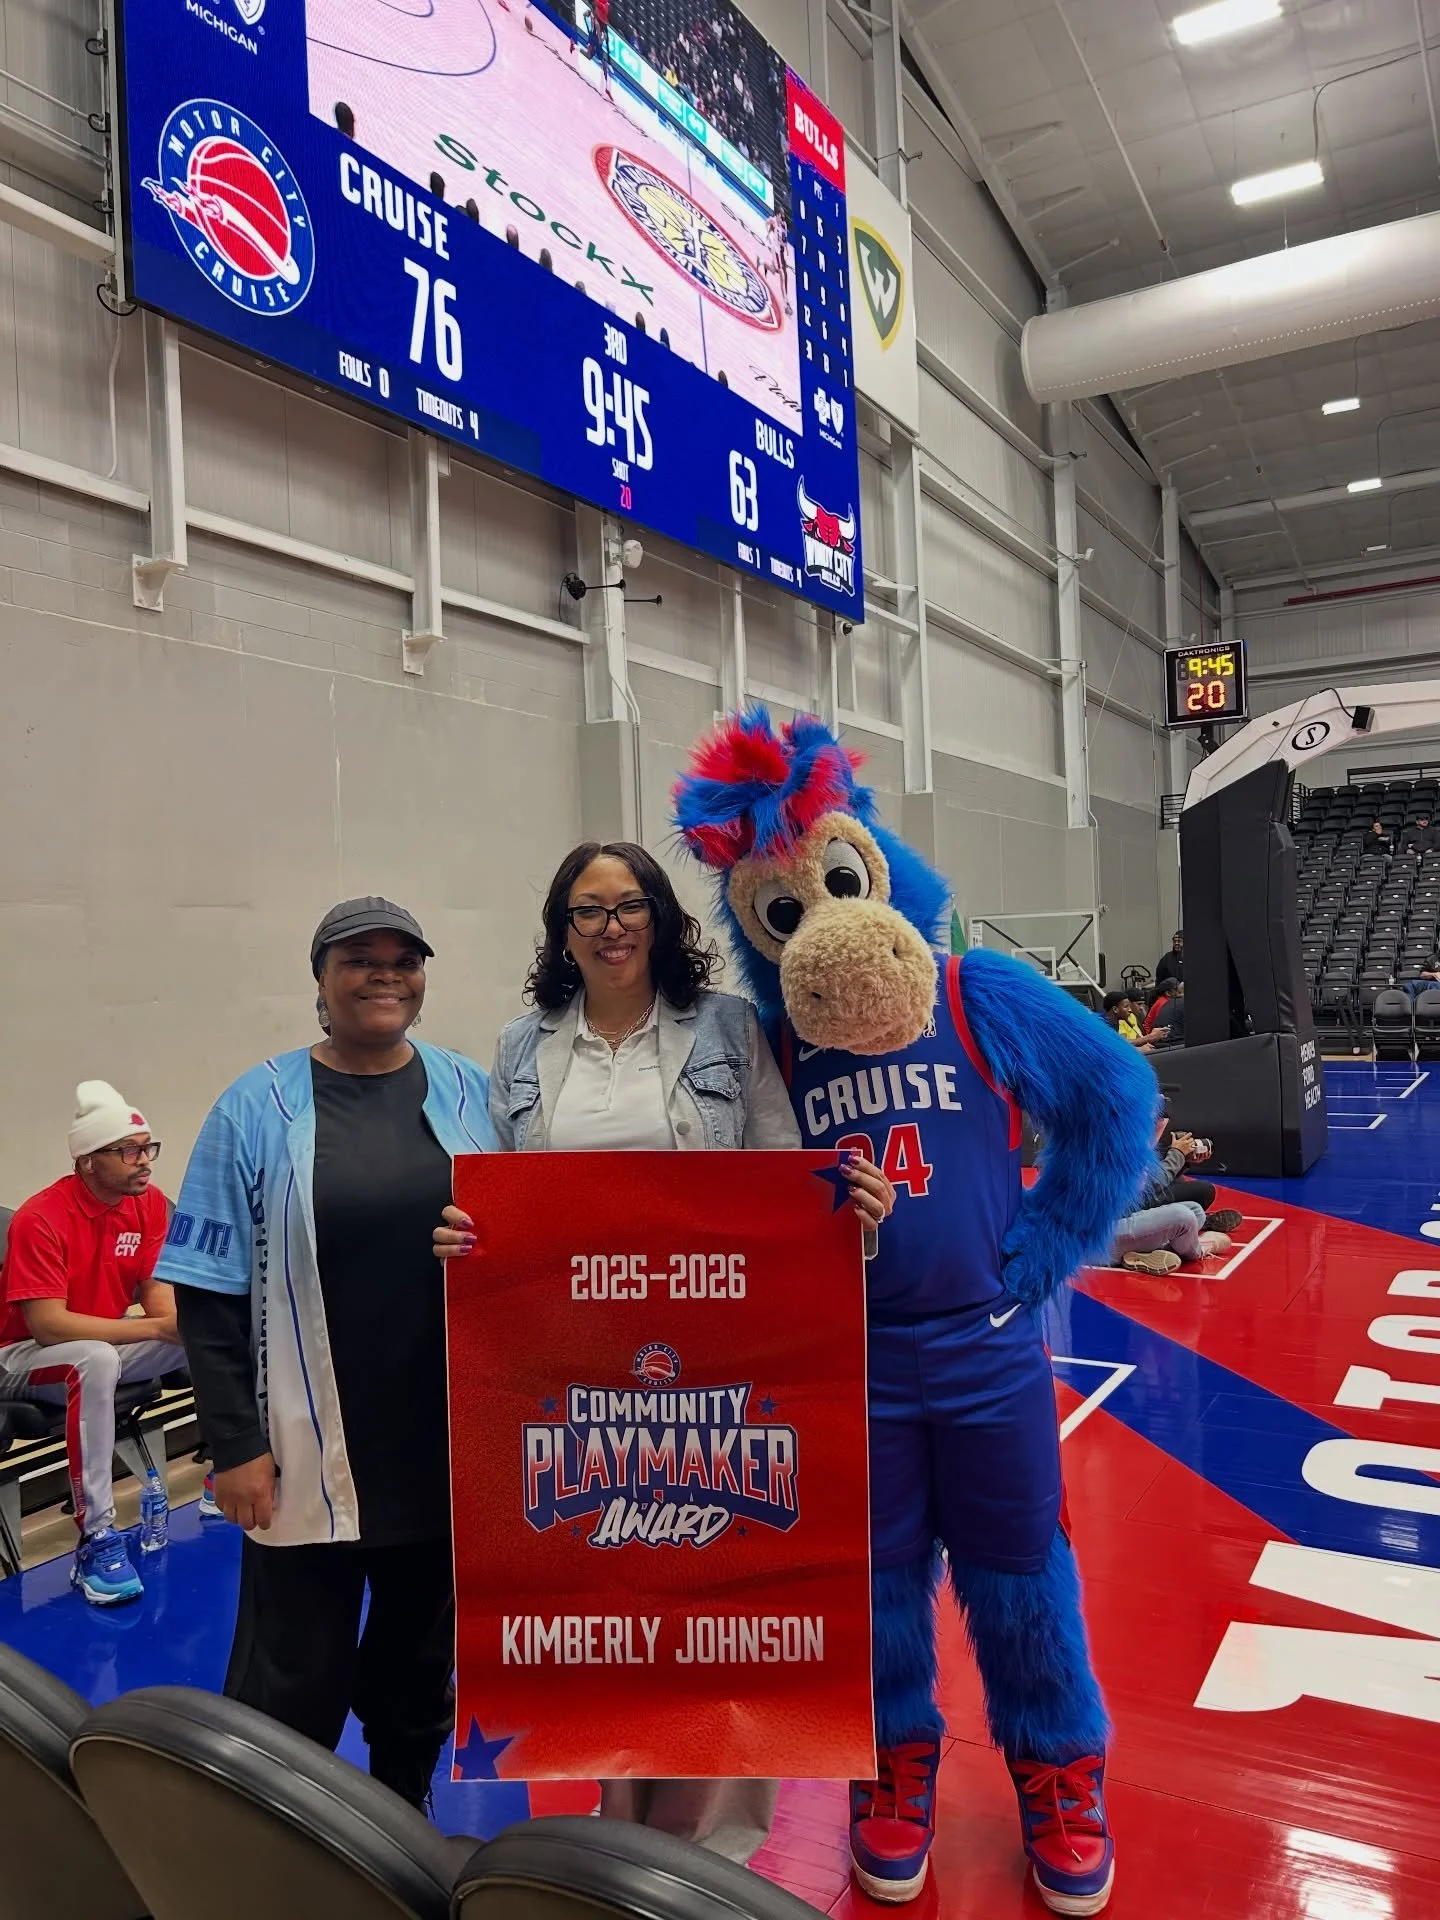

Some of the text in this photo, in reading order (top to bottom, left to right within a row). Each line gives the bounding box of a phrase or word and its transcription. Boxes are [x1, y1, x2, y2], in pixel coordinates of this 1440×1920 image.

[186, 0, 258, 55] MICHIGAN
[794, 103, 839, 171] BULLS
[168, 110, 307, 228] MOTOR CITY
[340, 152, 450, 261] CRUISE
[195, 241, 291, 306] CRUISE
[403, 257, 463, 382] 76
[603, 321, 628, 366] 3RD
[339, 350, 390, 399] FOULS 0
[416, 387, 479, 440] TIMEOUTS 4
[582, 356, 653, 471] 9:45
[755, 418, 794, 469] BULLS
[612, 457, 629, 483] SHOT
[729, 449, 759, 532] 63
[620, 484, 632, 511] 20
[834, 549, 853, 588] CITY
[1178, 645, 1230, 658] DAKTRONICS
[1188, 653, 1234, 678] 9:45
[1187, 680, 1226, 711] 20
[804, 1063, 963, 1137] CRUISE
[115, 1244, 138, 1257] CTY
[117, 1231, 142, 1245] MTR
[194, 1217, 233, 1259] IT!
[571, 1254, 746, 1300] 2025-2026
[571, 1386, 747, 1424] COMMUNITY
[526, 1427, 795, 1511] PLAYMAKER
[592, 1495, 730, 1545] AWARD
[502, 1615, 824, 1665] KIMBERLY JOHNSON
